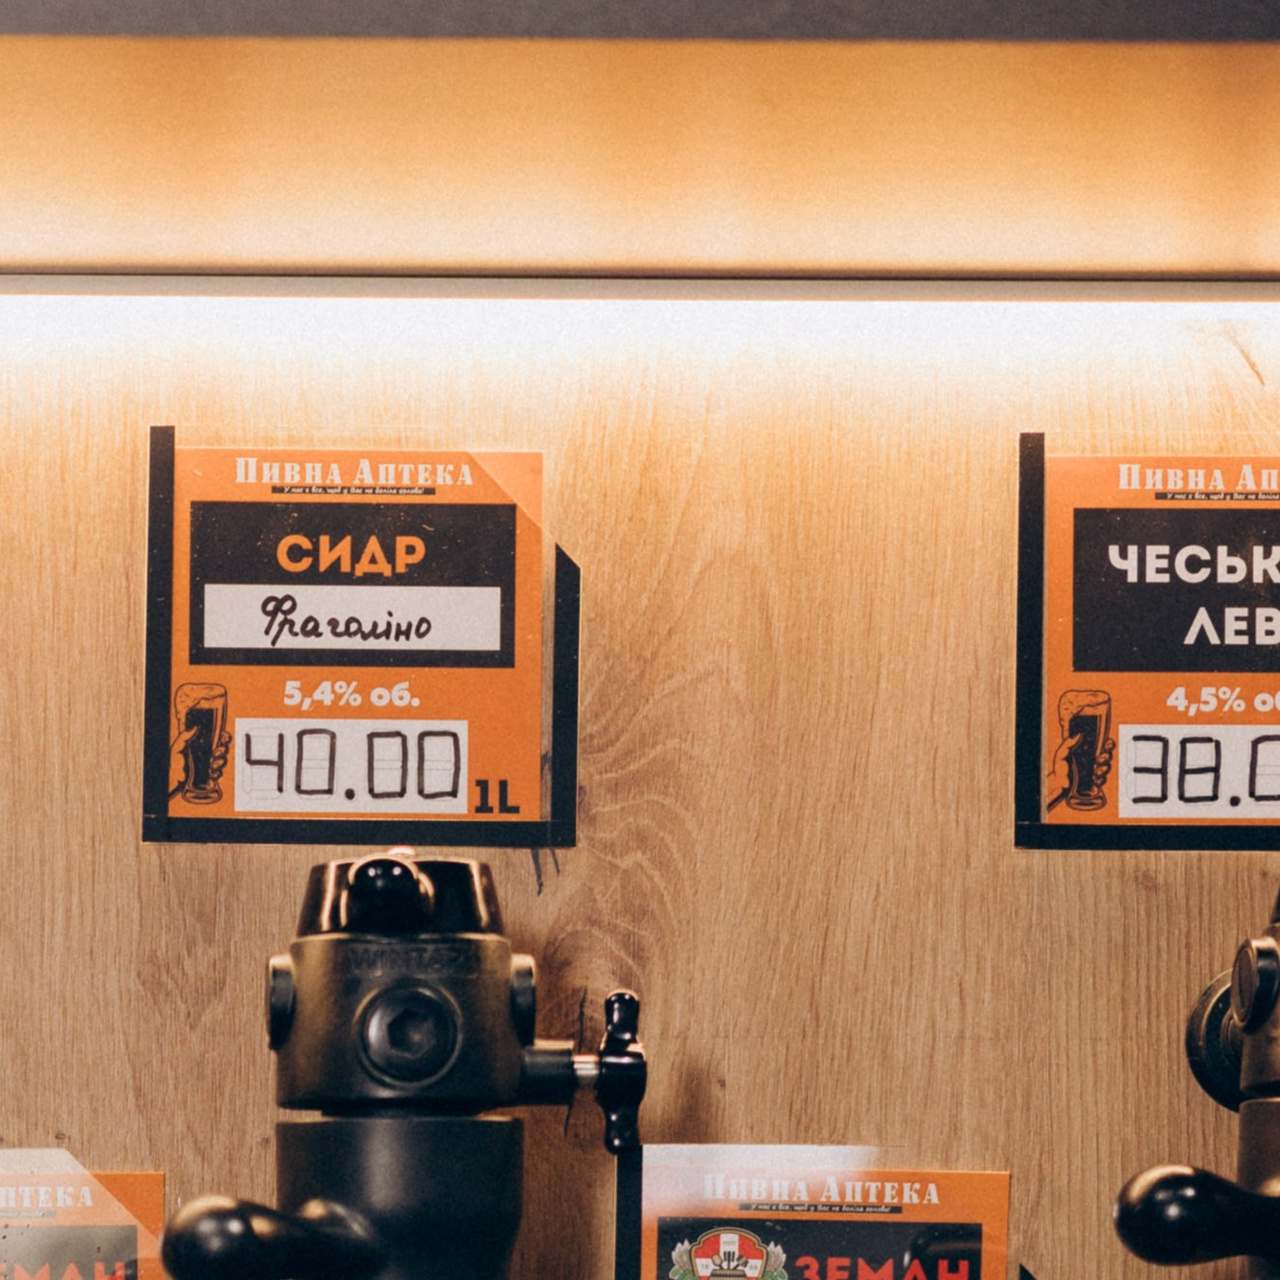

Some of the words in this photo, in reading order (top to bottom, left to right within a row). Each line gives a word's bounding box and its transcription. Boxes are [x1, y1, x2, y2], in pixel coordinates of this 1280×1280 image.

[276, 534, 426, 577] СИДР
[261, 594, 432, 647] Фраголіно
[283, 680, 362, 710] 5,4%
[1166, 686, 1245, 717] 4,5%
[244, 728, 461, 801] 40.00
[474, 779, 520, 814] 1L
